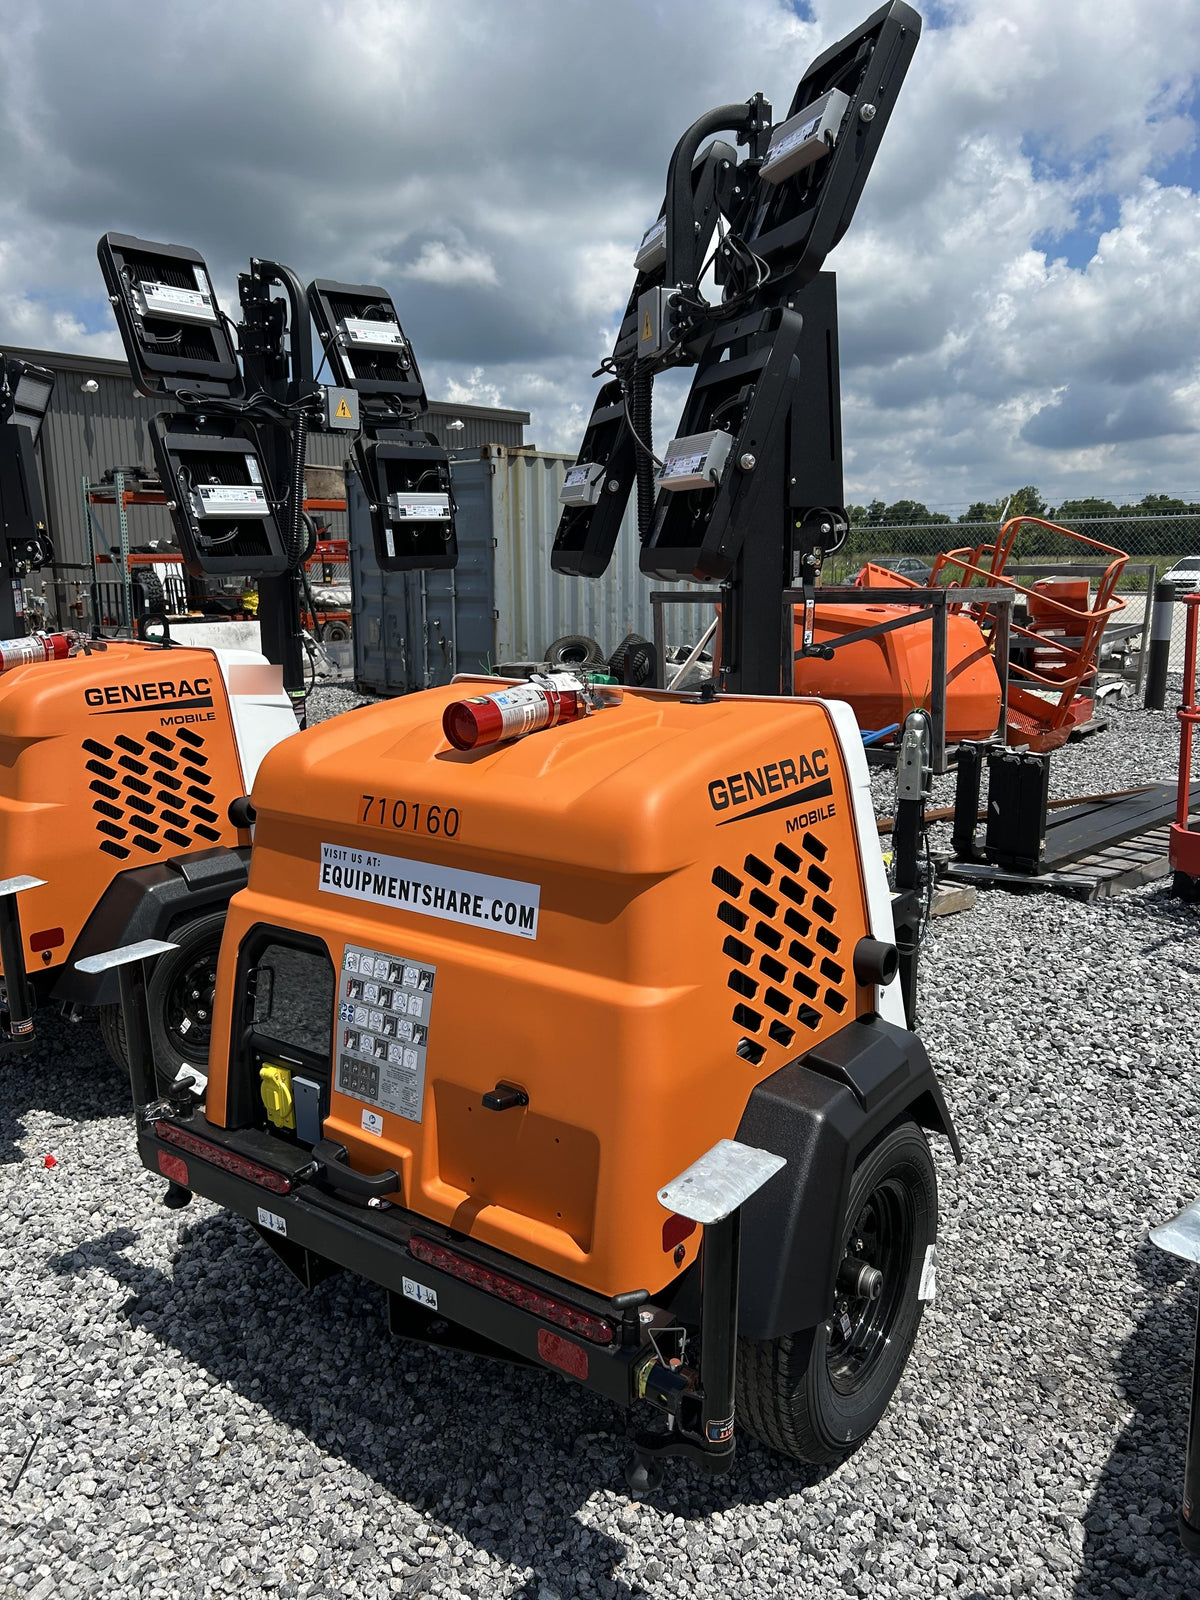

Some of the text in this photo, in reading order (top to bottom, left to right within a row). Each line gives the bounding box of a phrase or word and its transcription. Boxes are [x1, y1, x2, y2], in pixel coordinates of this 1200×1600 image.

[84, 678, 212, 707] GENERAC
[160, 712, 216, 726] MOBILE
[708, 749, 829, 811] GENERAC
[362, 795, 460, 837] 710160
[785, 803, 836, 833] MOBILE
[323, 847, 381, 867] VISIT US AT:
[322, 863, 536, 930] EQUIPMENTSHARE.COM
